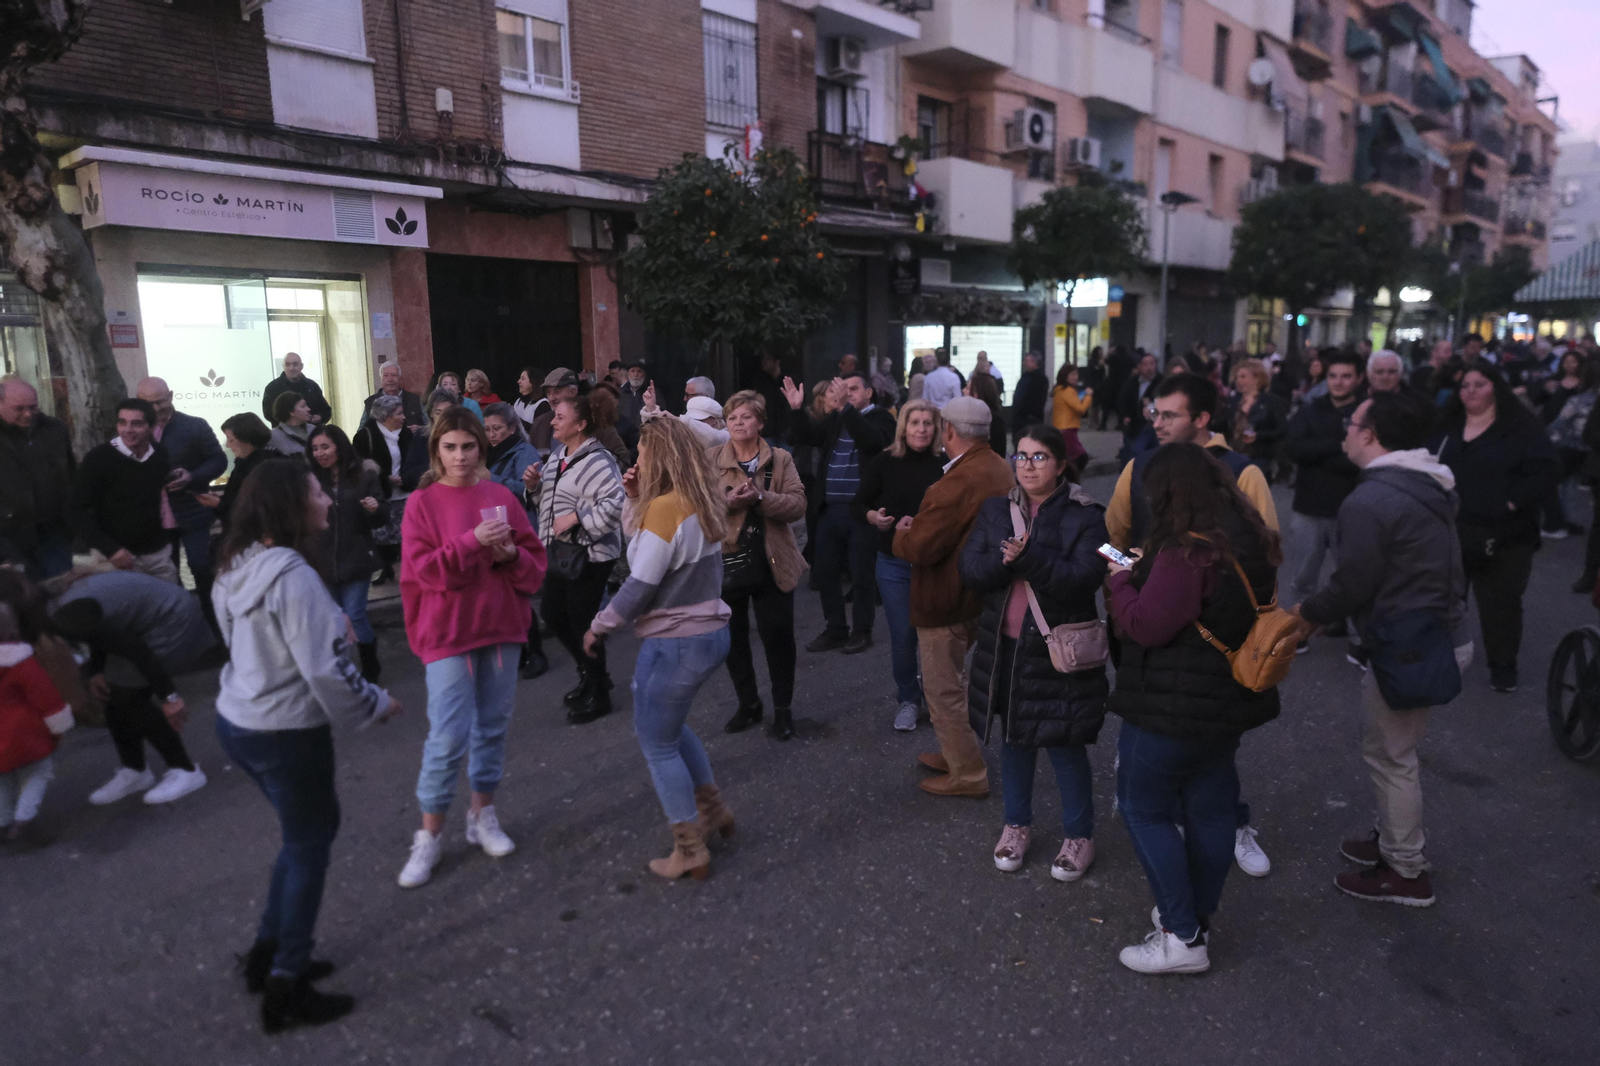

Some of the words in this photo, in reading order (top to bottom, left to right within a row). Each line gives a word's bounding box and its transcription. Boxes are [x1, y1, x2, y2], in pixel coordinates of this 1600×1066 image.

[141, 187, 205, 204] ROCÍO
[236, 197, 304, 213] MARTÍN
[182, 207, 218, 217] Centro
[221, 210, 261, 221] Estética
[173, 391, 208, 400] OCÍO
[212, 389, 261, 400] MARTÍN
